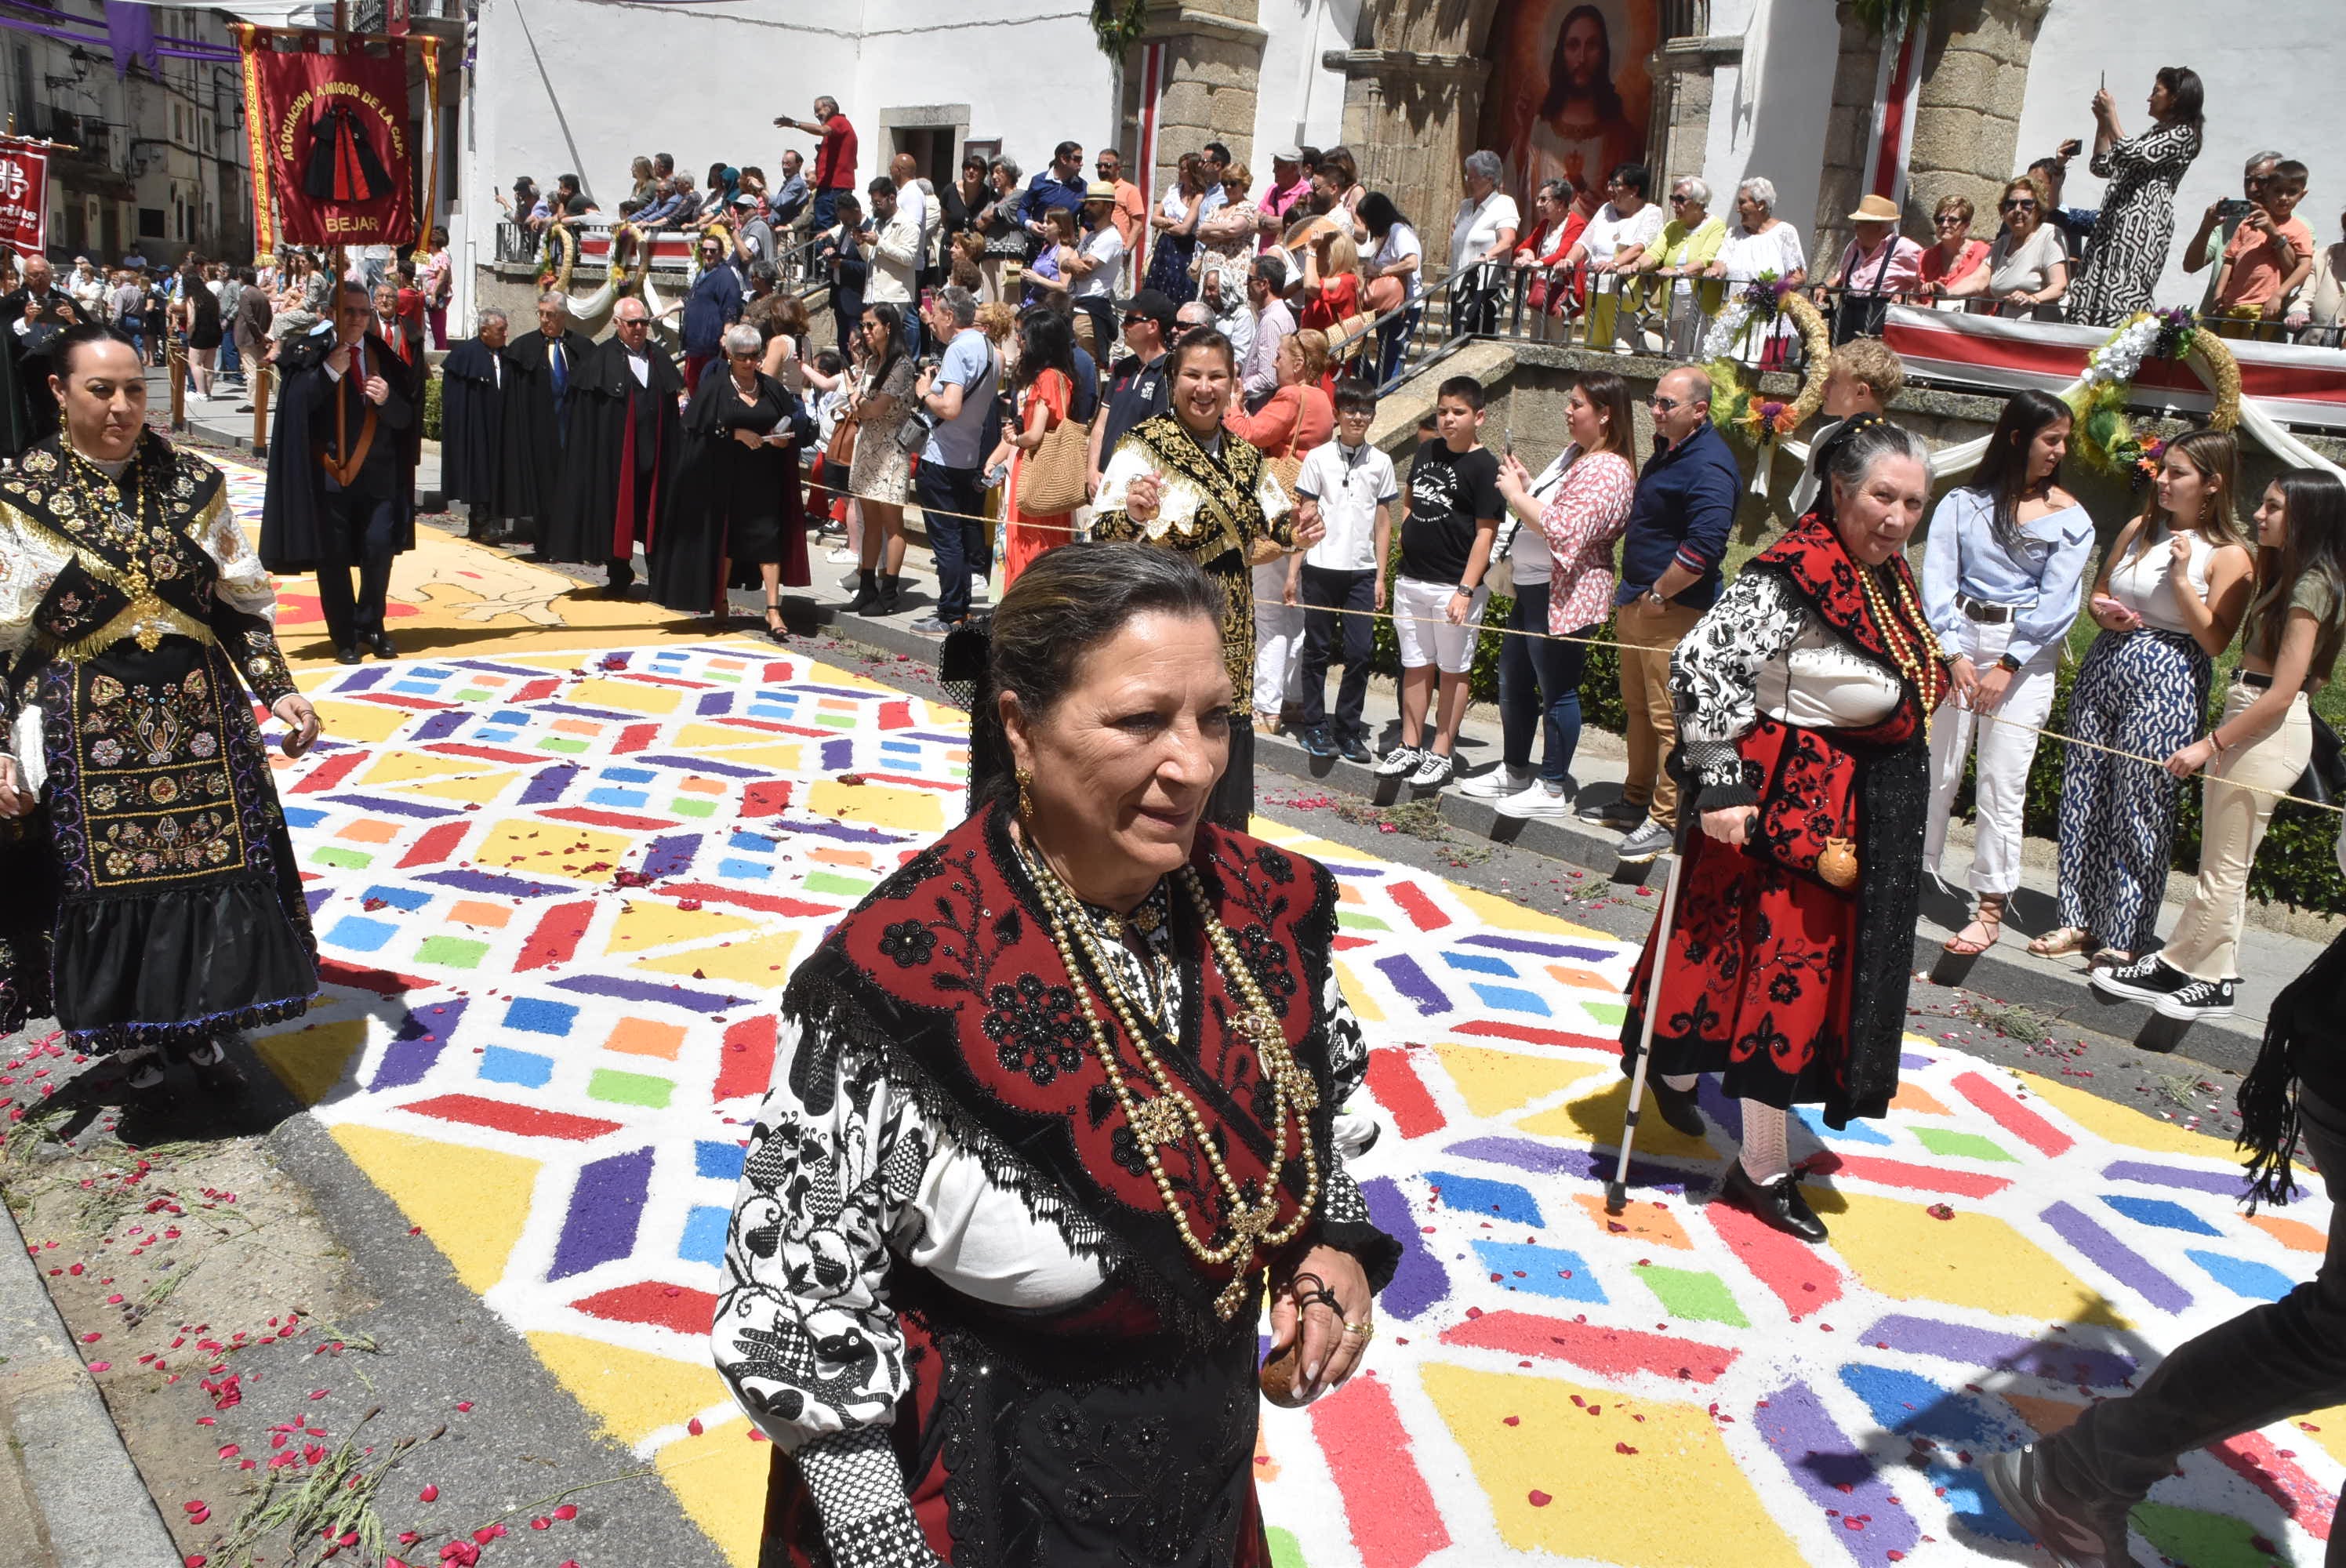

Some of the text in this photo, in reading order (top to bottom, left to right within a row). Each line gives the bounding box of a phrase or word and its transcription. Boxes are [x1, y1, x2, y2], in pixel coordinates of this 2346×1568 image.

[248, 85, 256, 111] CUNA
[251, 114, 260, 127] DE
[280, 81, 404, 162] ASOCIACION AMIGOS DE LA CAPA
[252, 131, 261, 145] LA
[254, 149, 263, 174] CAPA
[325, 216, 380, 233] BEJAR
[1417, 461, 1458, 490] AUTHENTIC
